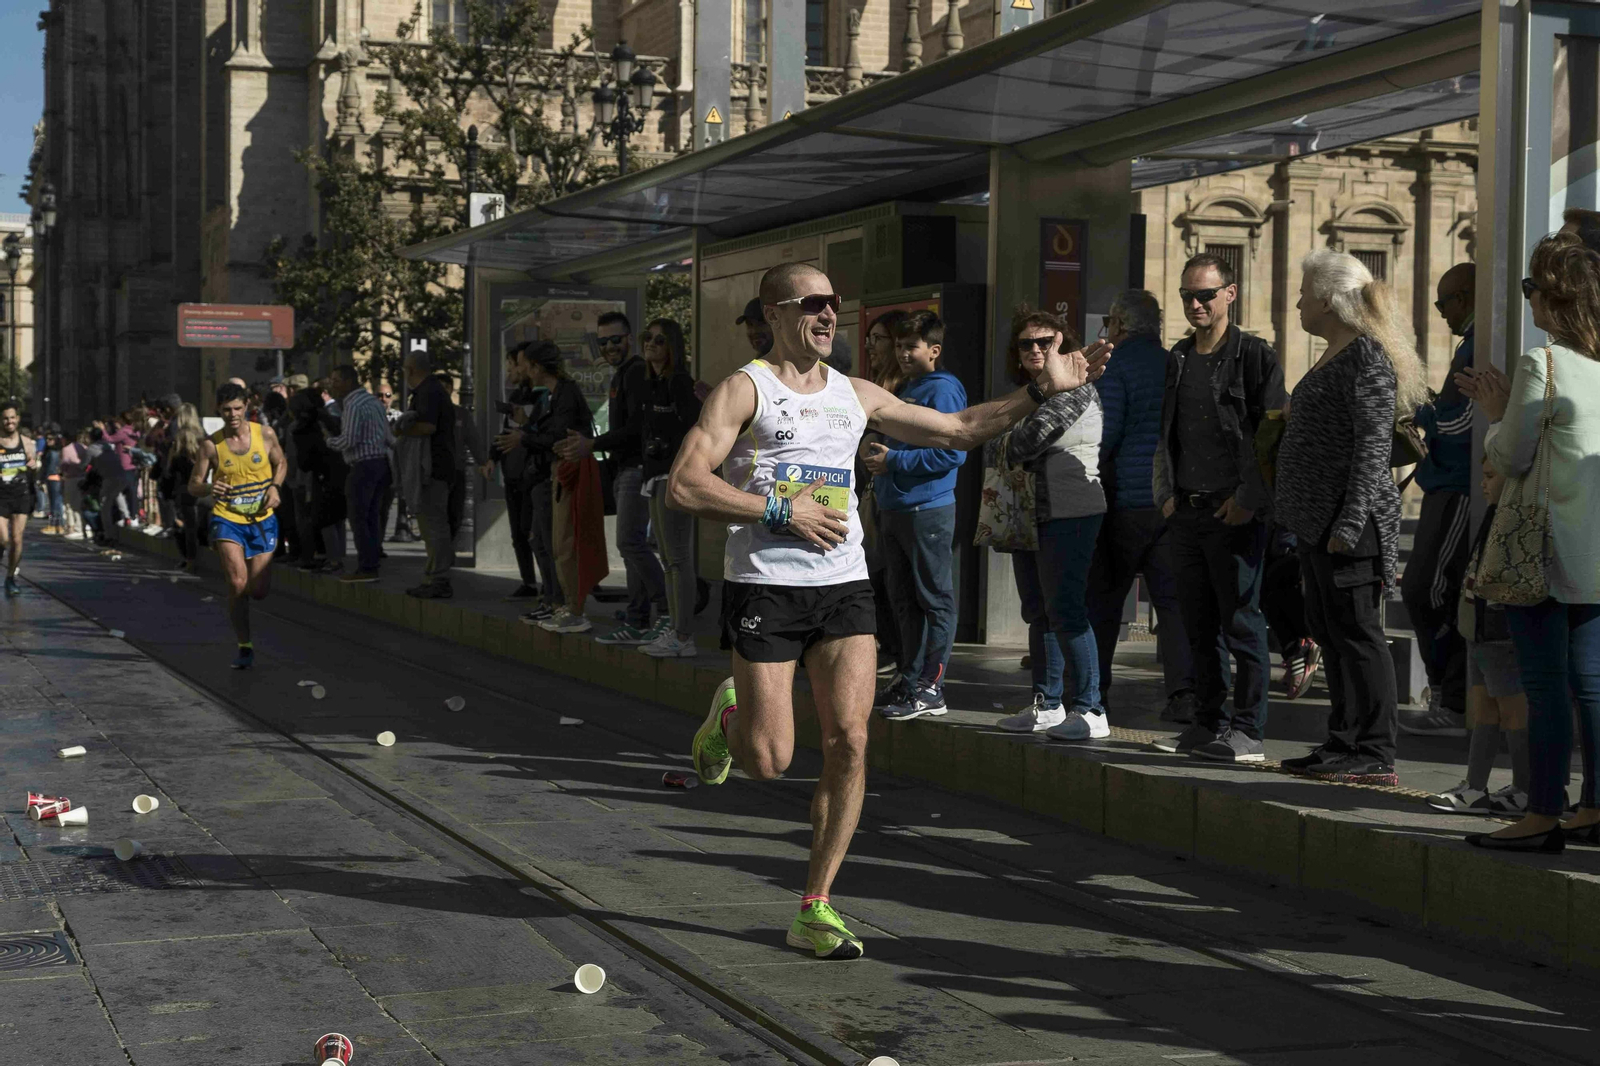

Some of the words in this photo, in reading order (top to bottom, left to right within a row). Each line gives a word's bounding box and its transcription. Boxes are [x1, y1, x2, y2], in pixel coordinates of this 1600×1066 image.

[826, 420, 852, 430] TEAM
[775, 430, 794, 441] GO
[805, 470, 844, 483] ZURICH
[741, 617, 757, 629] GO
